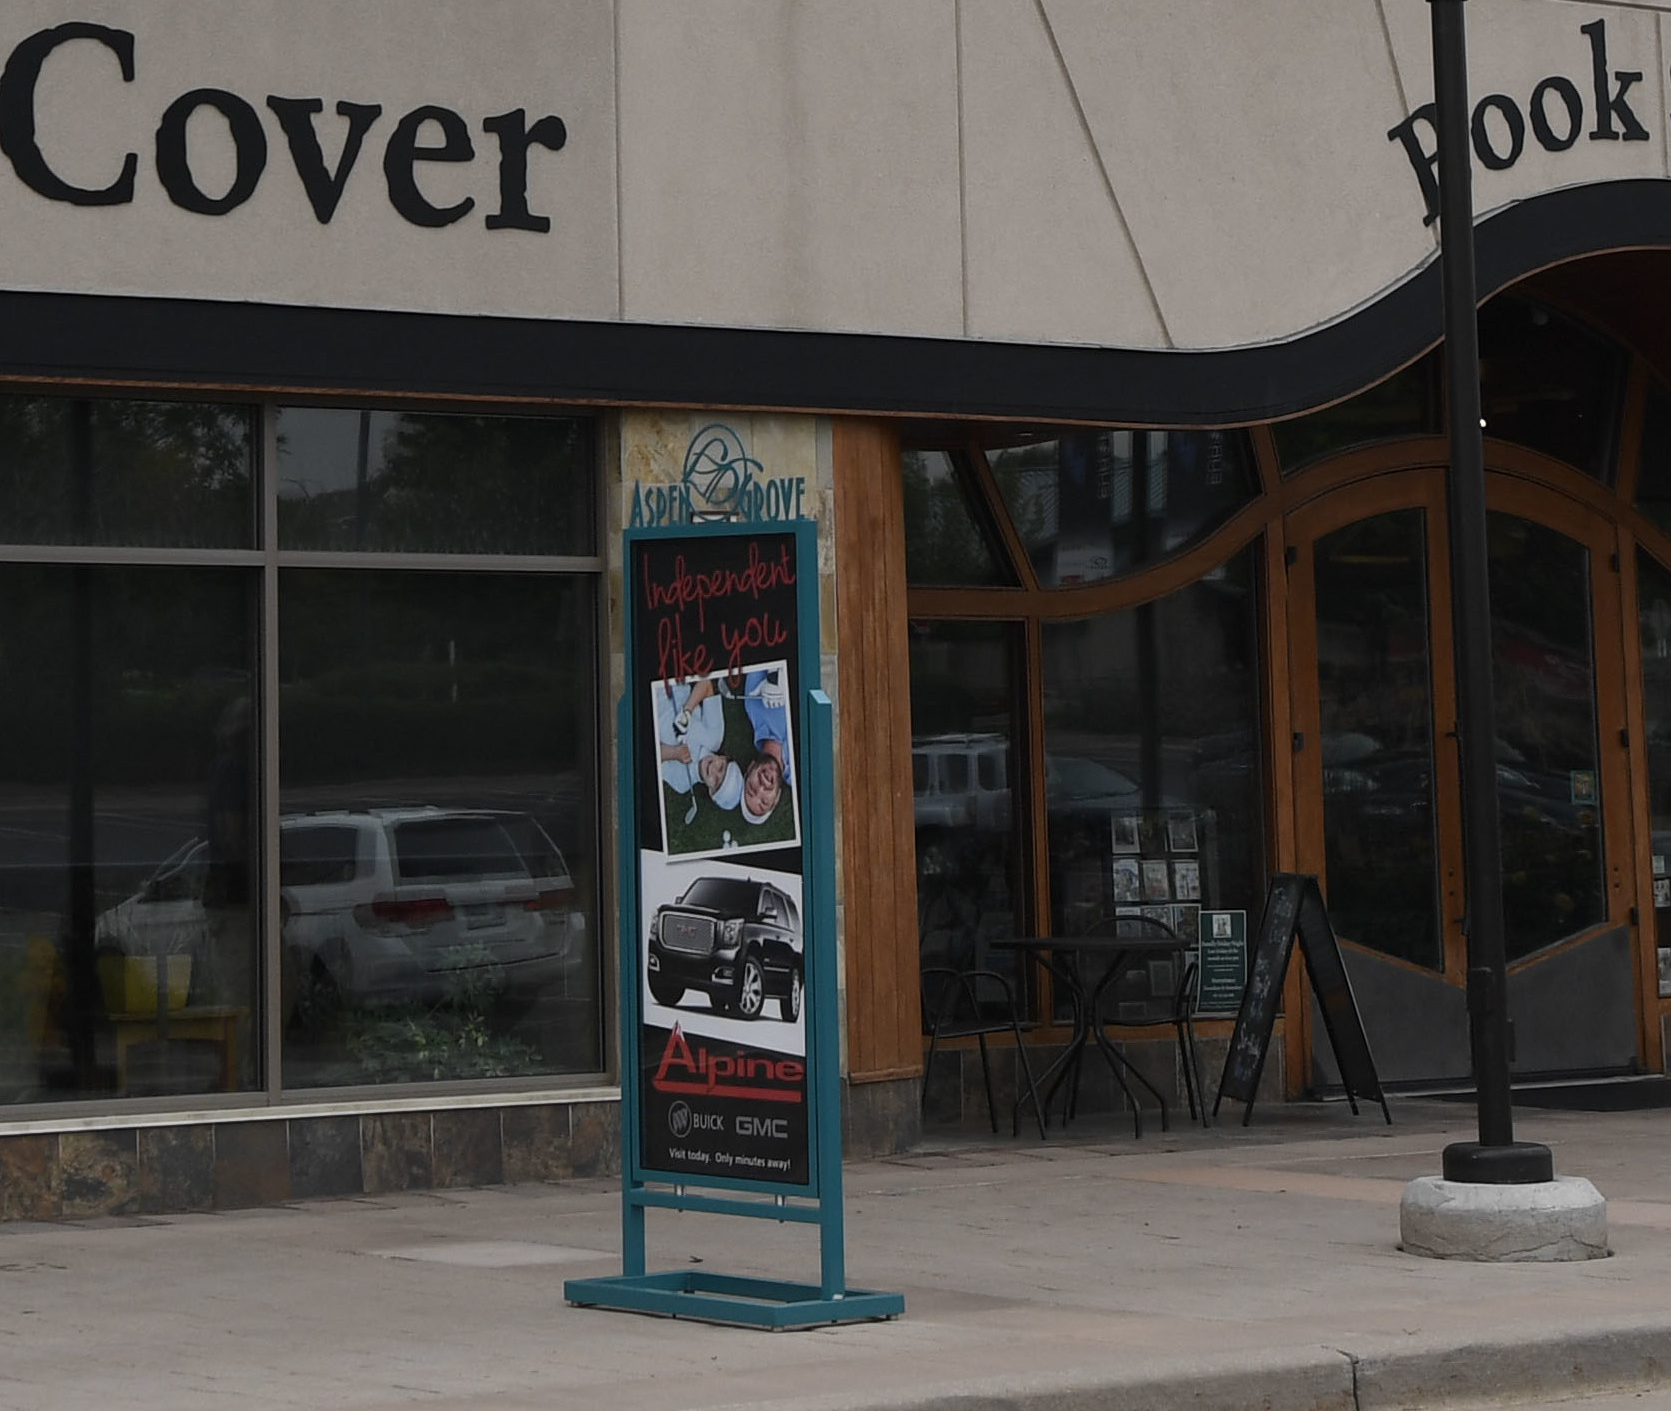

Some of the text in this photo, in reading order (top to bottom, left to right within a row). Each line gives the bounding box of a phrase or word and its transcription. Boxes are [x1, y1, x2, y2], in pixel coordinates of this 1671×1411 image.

[630, 473, 806, 527] ASPEN GROVE
[643, 542, 796, 633] Independent
[658, 612, 788, 699] like you
[652, 1019, 805, 1097] Alpine
[693, 1113, 788, 1138] BUICK GMC
[669, 1148, 791, 1171] Visit today. Only minutes away!
